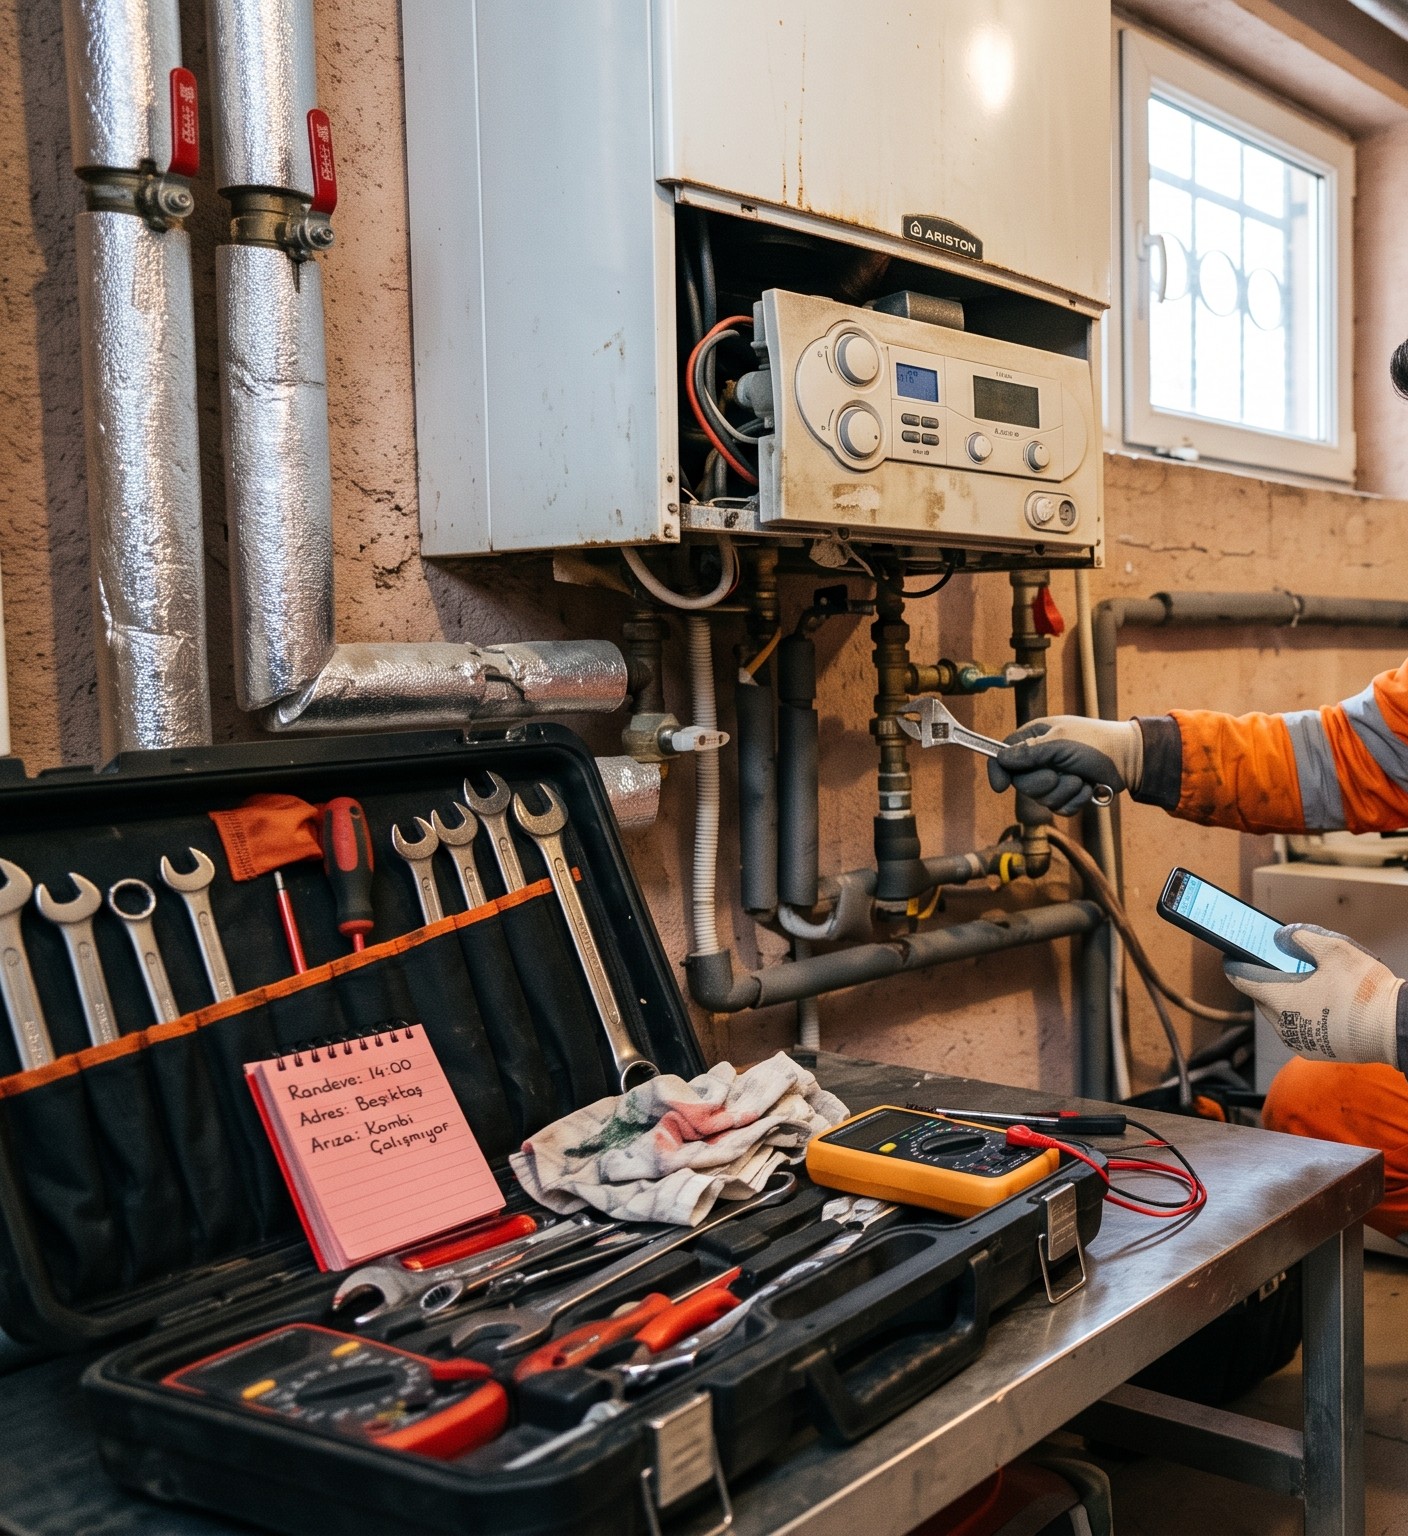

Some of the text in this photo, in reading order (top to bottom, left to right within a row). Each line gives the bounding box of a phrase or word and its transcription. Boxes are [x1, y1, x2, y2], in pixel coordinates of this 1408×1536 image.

[925, 230, 976, 253] ARISTON
[288, 1059, 412, 1100] Randeve: 14:00
[300, 1105, 350, 1127] Adres:
[312, 1114, 414, 1153] Arıza: Kombi
